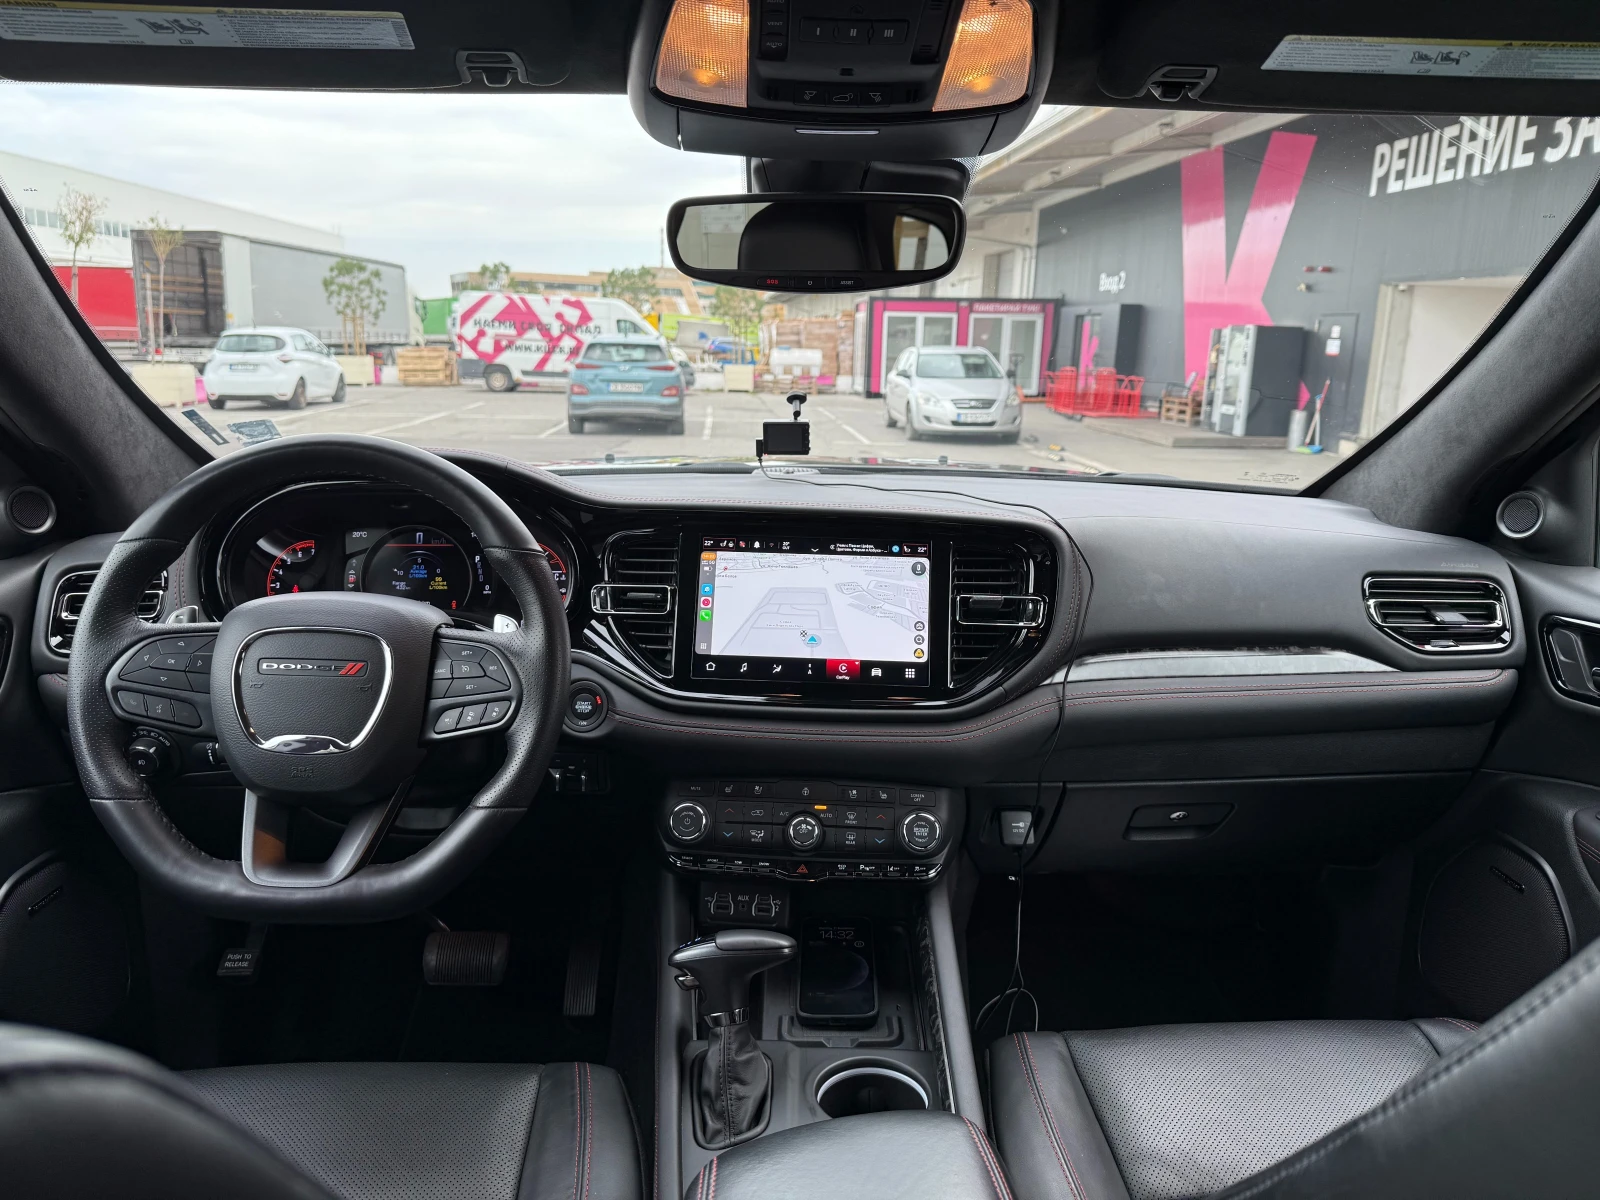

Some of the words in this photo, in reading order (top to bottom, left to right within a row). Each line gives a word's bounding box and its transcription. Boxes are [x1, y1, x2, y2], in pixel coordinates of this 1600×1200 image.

[1369, 115, 1538, 198] РЕШЕНИЕ
[262, 662, 346, 673] DODGE
[819, 930, 855, 940] 14:32
